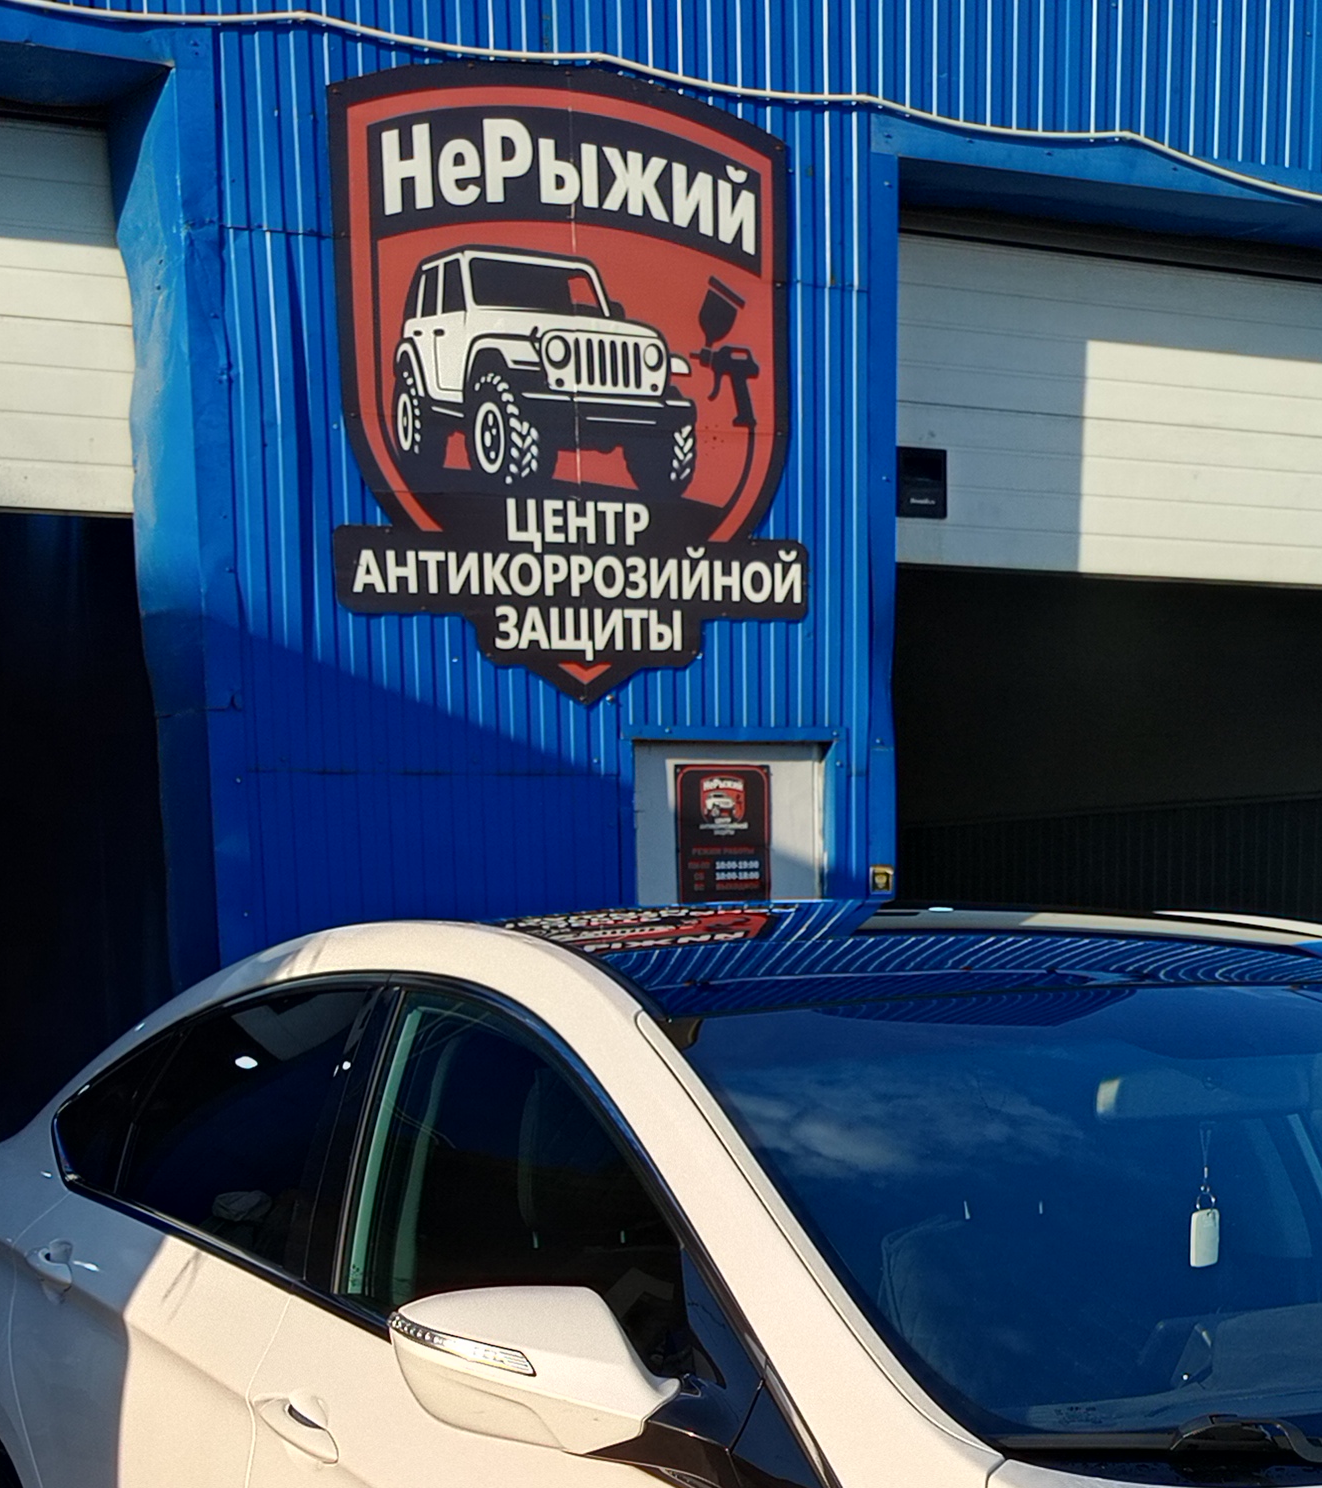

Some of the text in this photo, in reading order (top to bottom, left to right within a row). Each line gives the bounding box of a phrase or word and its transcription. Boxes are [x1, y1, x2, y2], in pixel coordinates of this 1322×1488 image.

[381, 118, 757, 255] НеРыжий
[505, 498, 650, 552] ЦЕНТР
[352, 546, 803, 604] АНТИКОРРОЗИЙНОЙ
[494, 606, 683, 661] ЗАЩИТЫ
